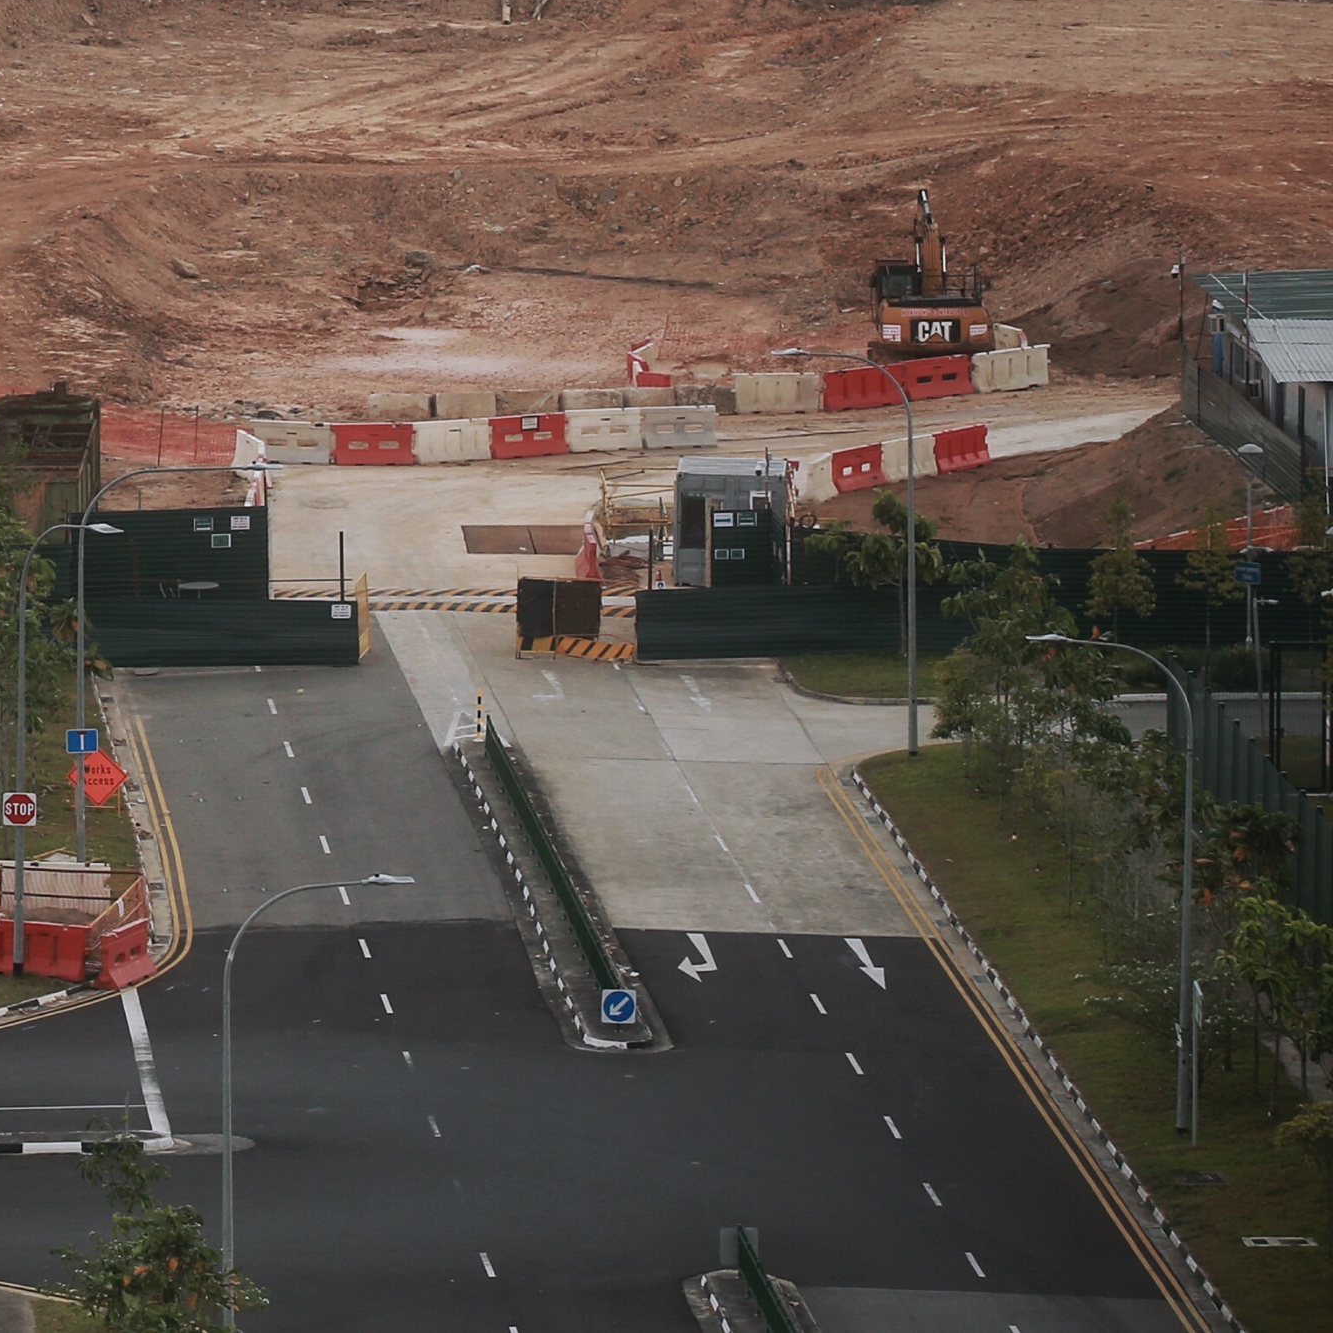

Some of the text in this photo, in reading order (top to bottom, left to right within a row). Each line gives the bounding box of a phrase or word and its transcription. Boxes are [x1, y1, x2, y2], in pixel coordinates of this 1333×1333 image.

[917, 321, 952, 343] CAT
[84, 764, 111, 775] Works
[5, 802, 35, 816] STOP
